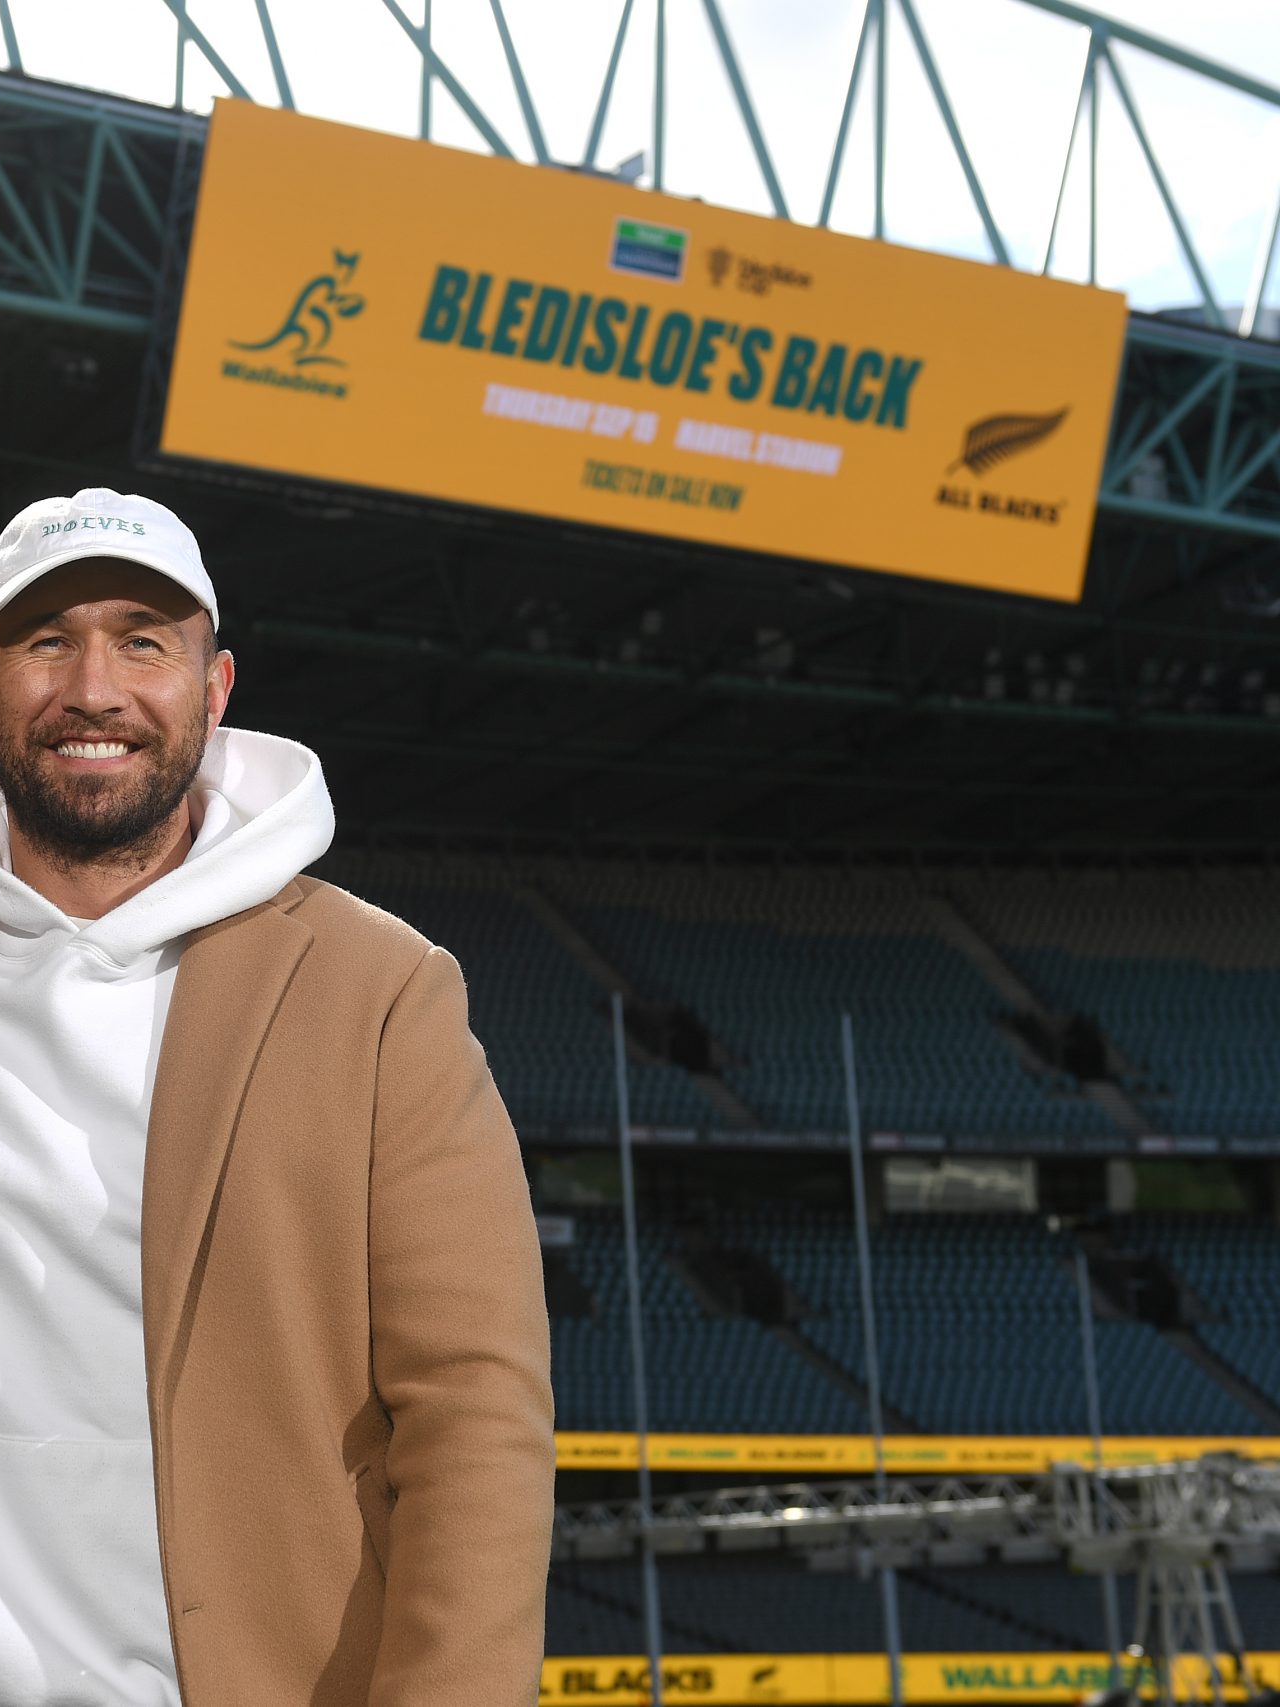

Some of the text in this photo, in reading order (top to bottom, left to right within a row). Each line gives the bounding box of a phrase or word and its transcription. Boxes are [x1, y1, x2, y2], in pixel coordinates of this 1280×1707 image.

[418, 265, 924, 429] BLEDISLOE'S BACK
[937, 485, 1060, 525] ALL BLACKS
[41, 516, 146, 537] WOLVES
